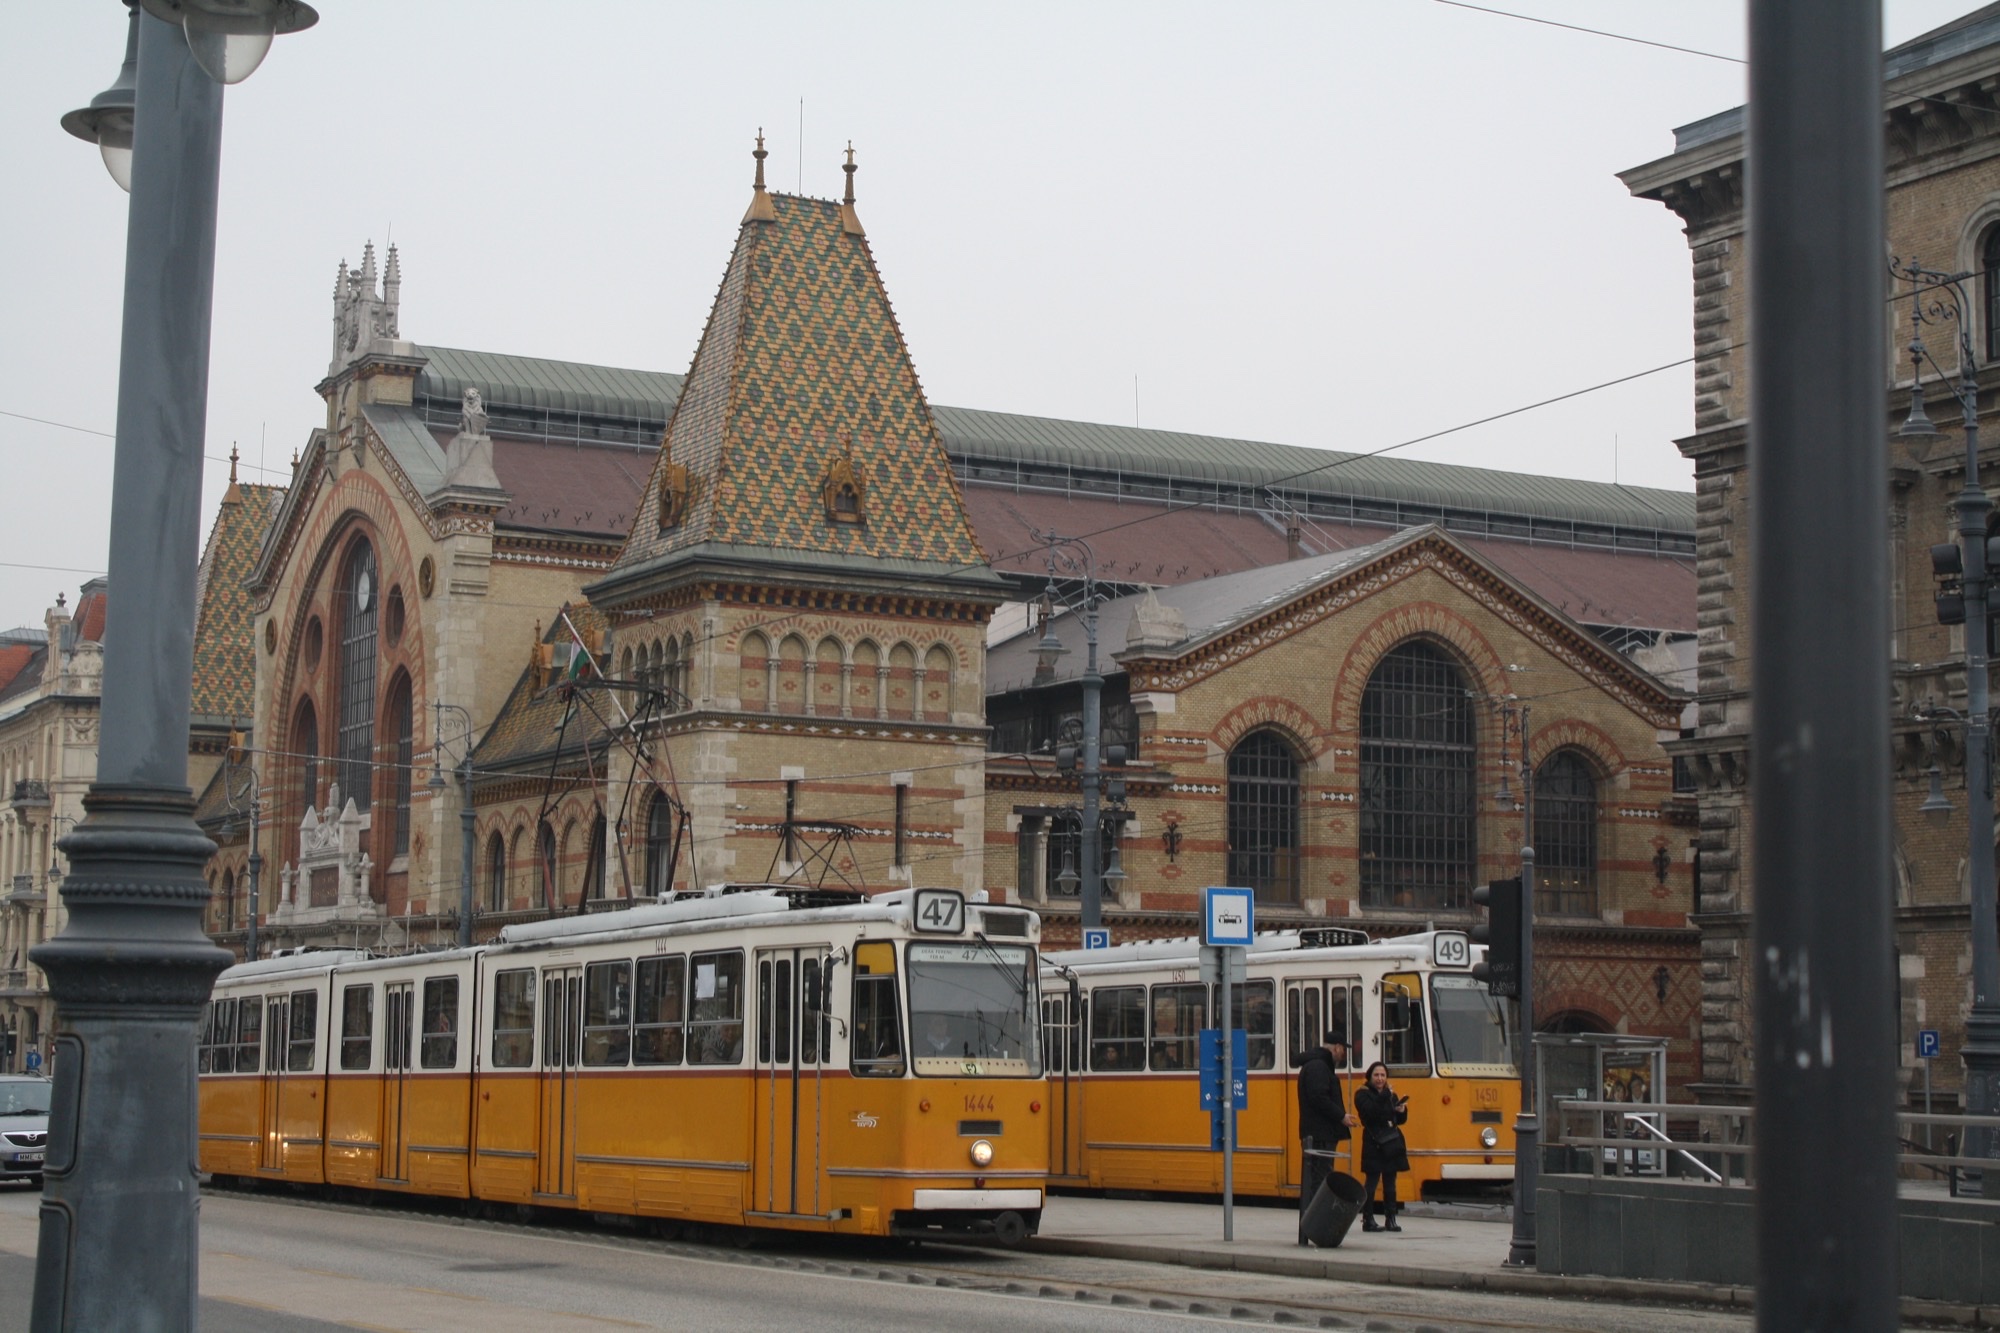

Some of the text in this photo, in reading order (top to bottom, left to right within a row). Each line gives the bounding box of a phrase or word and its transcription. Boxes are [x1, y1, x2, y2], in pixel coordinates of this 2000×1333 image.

[922, 898, 958, 926] 47
[1090, 934, 1103, 949] P
[962, 950, 978, 961] 47
[1439, 940, 1465, 961] 49
[1172, 969, 1186, 984] 1450
[1924, 1034, 1935, 1054] P
[964, 1094, 994, 1113] 1444
[1475, 1088, 1498, 1102] 1450
